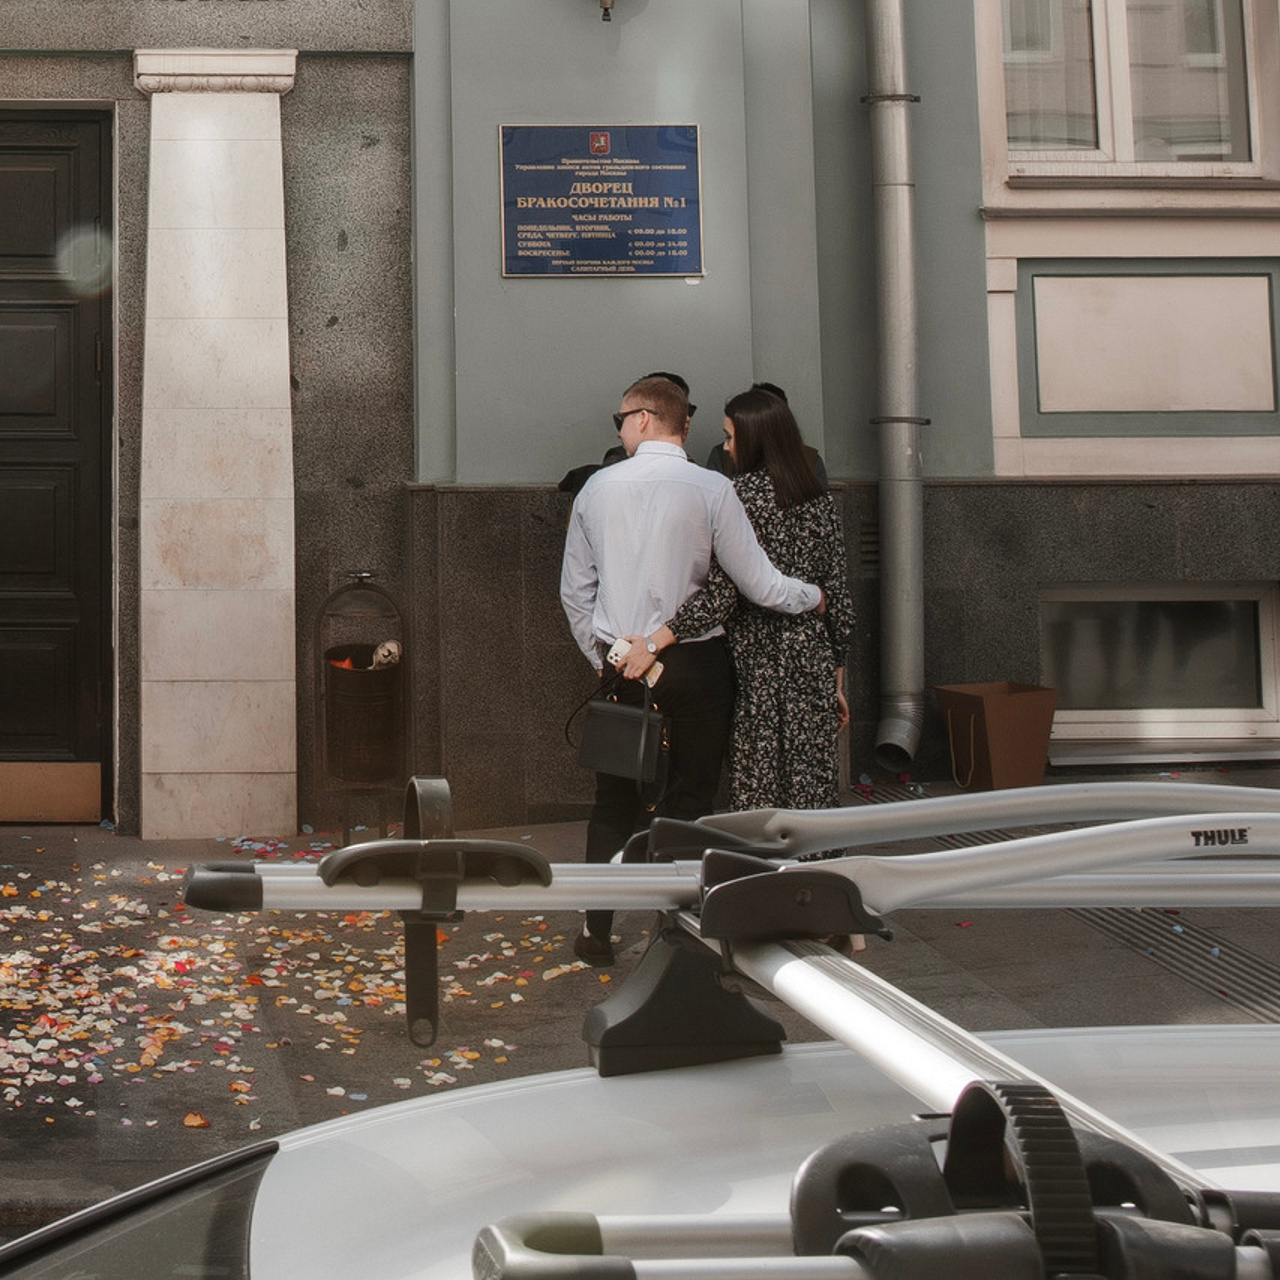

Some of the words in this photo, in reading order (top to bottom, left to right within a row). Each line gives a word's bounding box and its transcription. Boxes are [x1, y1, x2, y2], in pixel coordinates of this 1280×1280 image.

[569, 182, 634, 195] ДВОРЕЦ
[516, 197, 659, 209] БРАКОСОЧЕТАНИЯ
[1190, 828, 1249, 847] THULE
